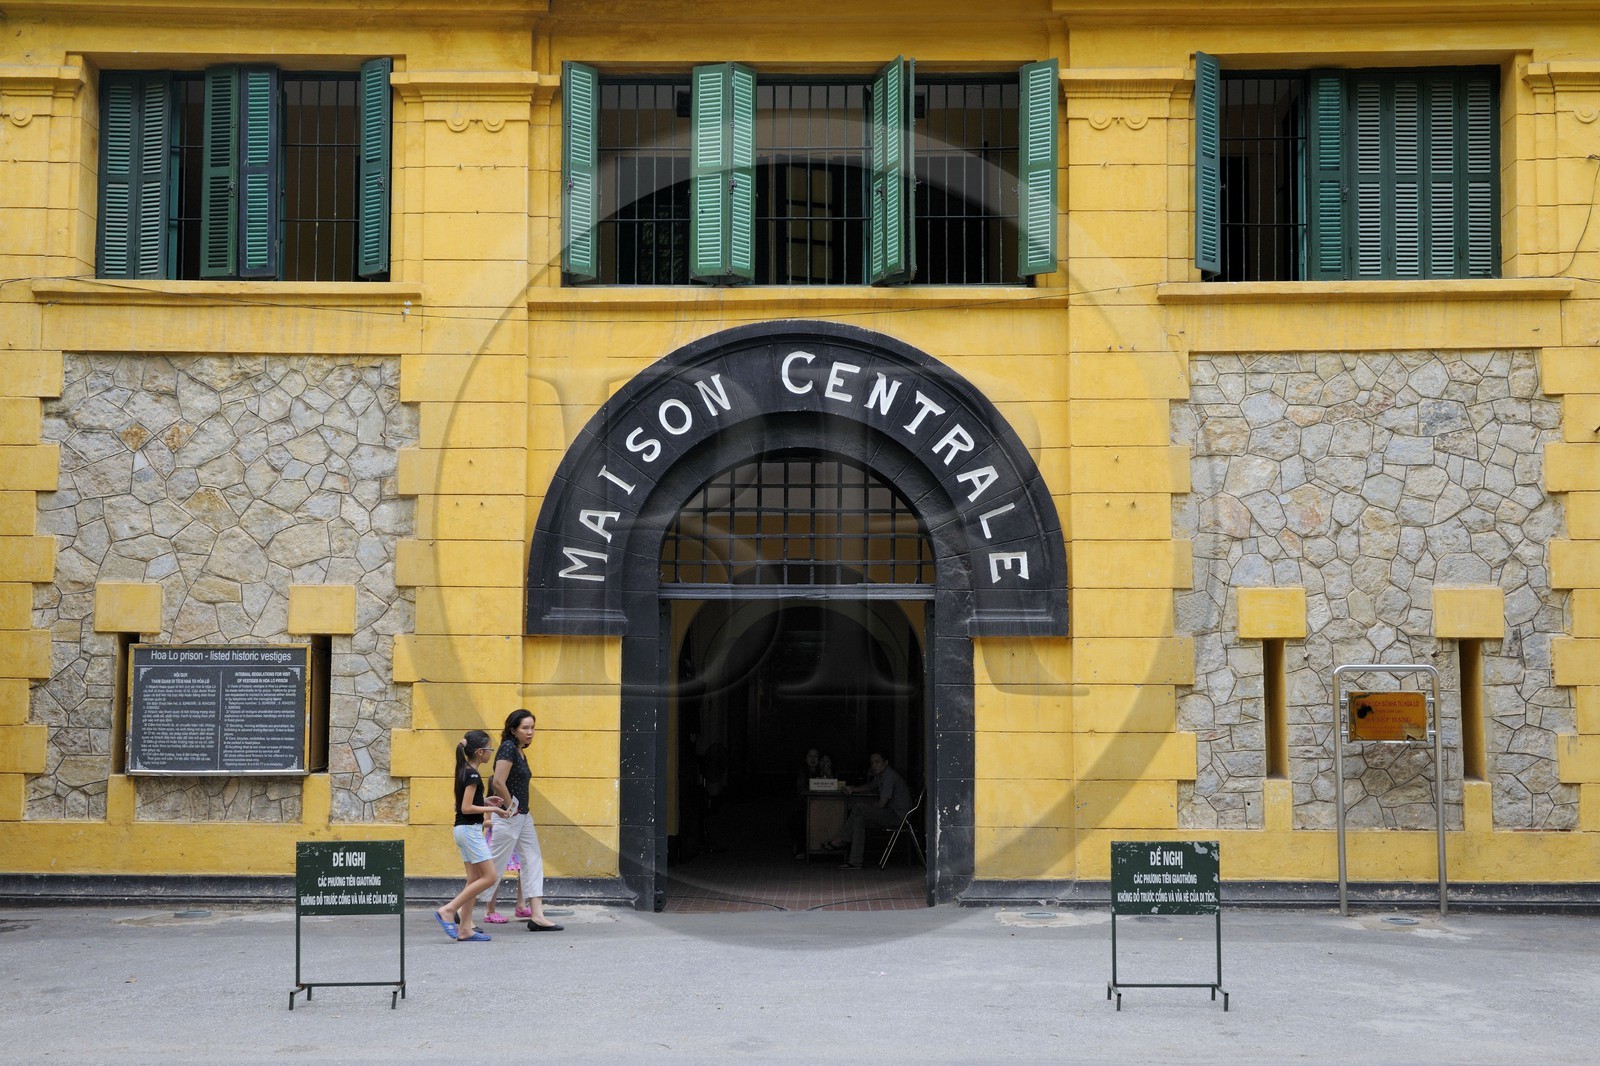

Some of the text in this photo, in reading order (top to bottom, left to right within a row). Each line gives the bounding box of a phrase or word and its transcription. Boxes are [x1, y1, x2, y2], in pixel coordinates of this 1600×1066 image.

[559, 351, 1030, 584] MAISON CENTRALE
[151, 650, 166, 660] Hoa
[169, 650, 178, 660] Lo
[180, 652, 203, 662] prison
[210, 651, 230, 660] listed
[232, 651, 259, 660] historic
[261, 652, 291, 663] vestiges
[346, 852, 366, 869] NGHỊ
[1150, 846, 1183, 869] ĐỀ NGHỊ
[318, 875, 327, 887] CÁC
[1134, 872, 1143, 884] CÁC
[351, 893, 357, 904] VÀ
[382, 894, 387, 904] DI
[1117, 890, 1132, 902] KHÔNG
[1168, 890, 1174, 902] VÀ
[1183, 890, 1189, 902] HÈ
[1190, 889, 1199, 902] CỦA
[1200, 892, 1204, 902] DI
